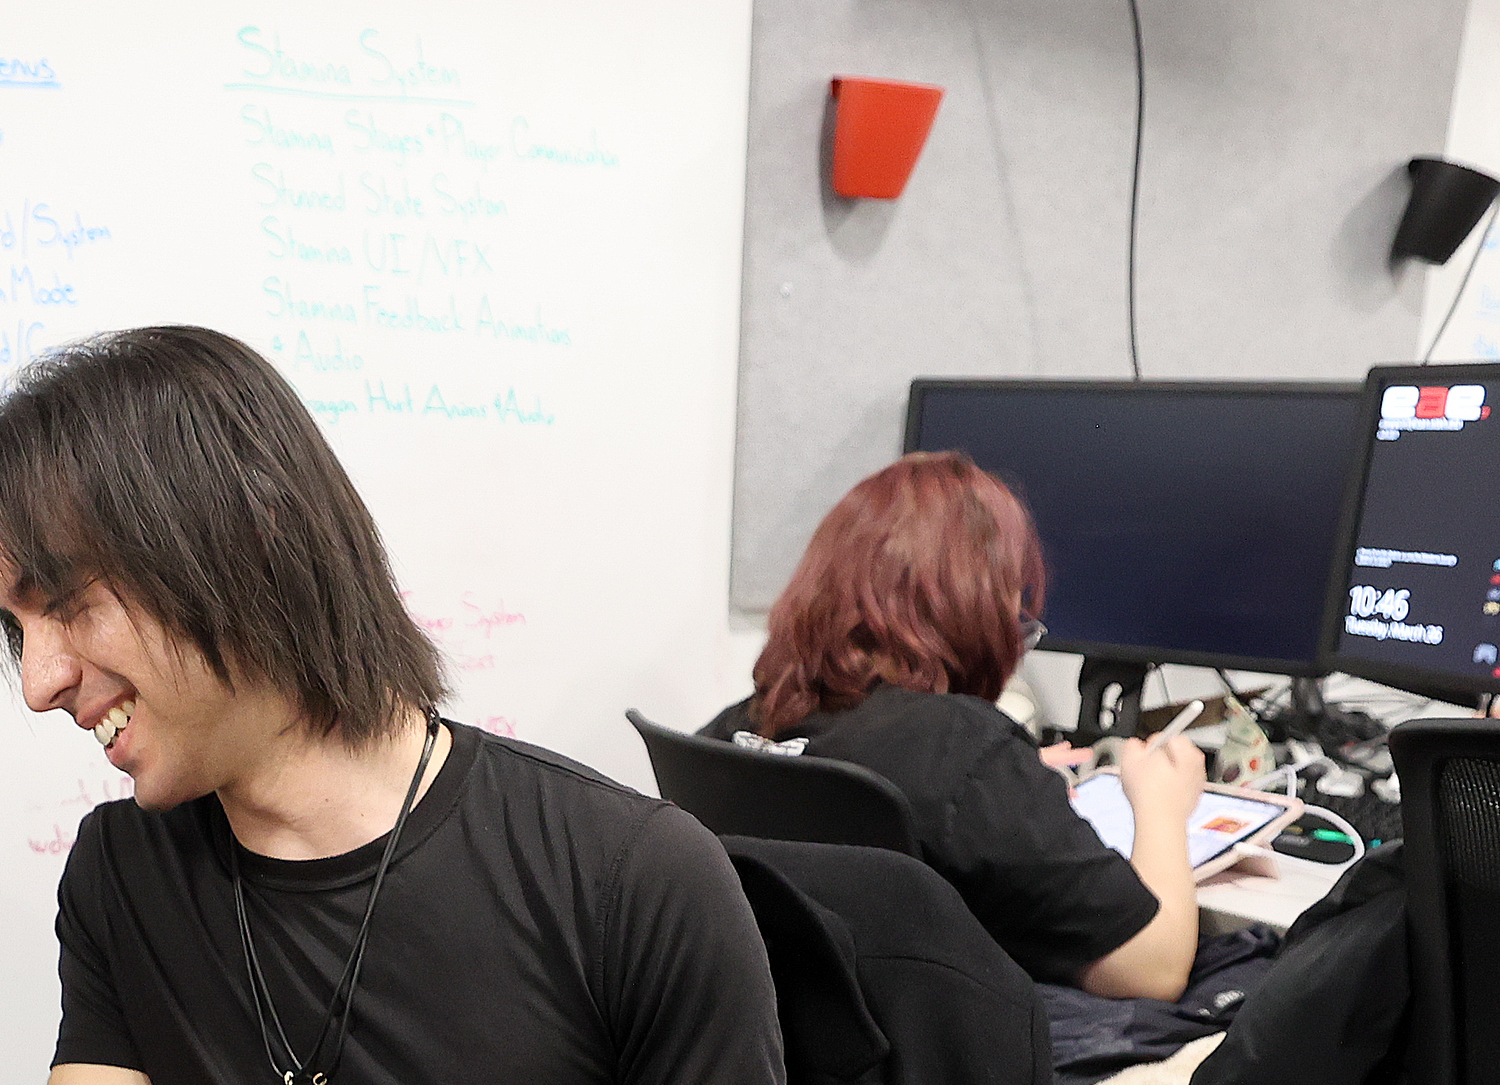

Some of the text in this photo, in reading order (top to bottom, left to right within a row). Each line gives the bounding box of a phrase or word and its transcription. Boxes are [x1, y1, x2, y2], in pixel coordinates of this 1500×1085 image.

[236, 24, 462, 104] Stamina System
[295, 328, 365, 373] Audio
[1350, 584, 1412, 621] 10:46
